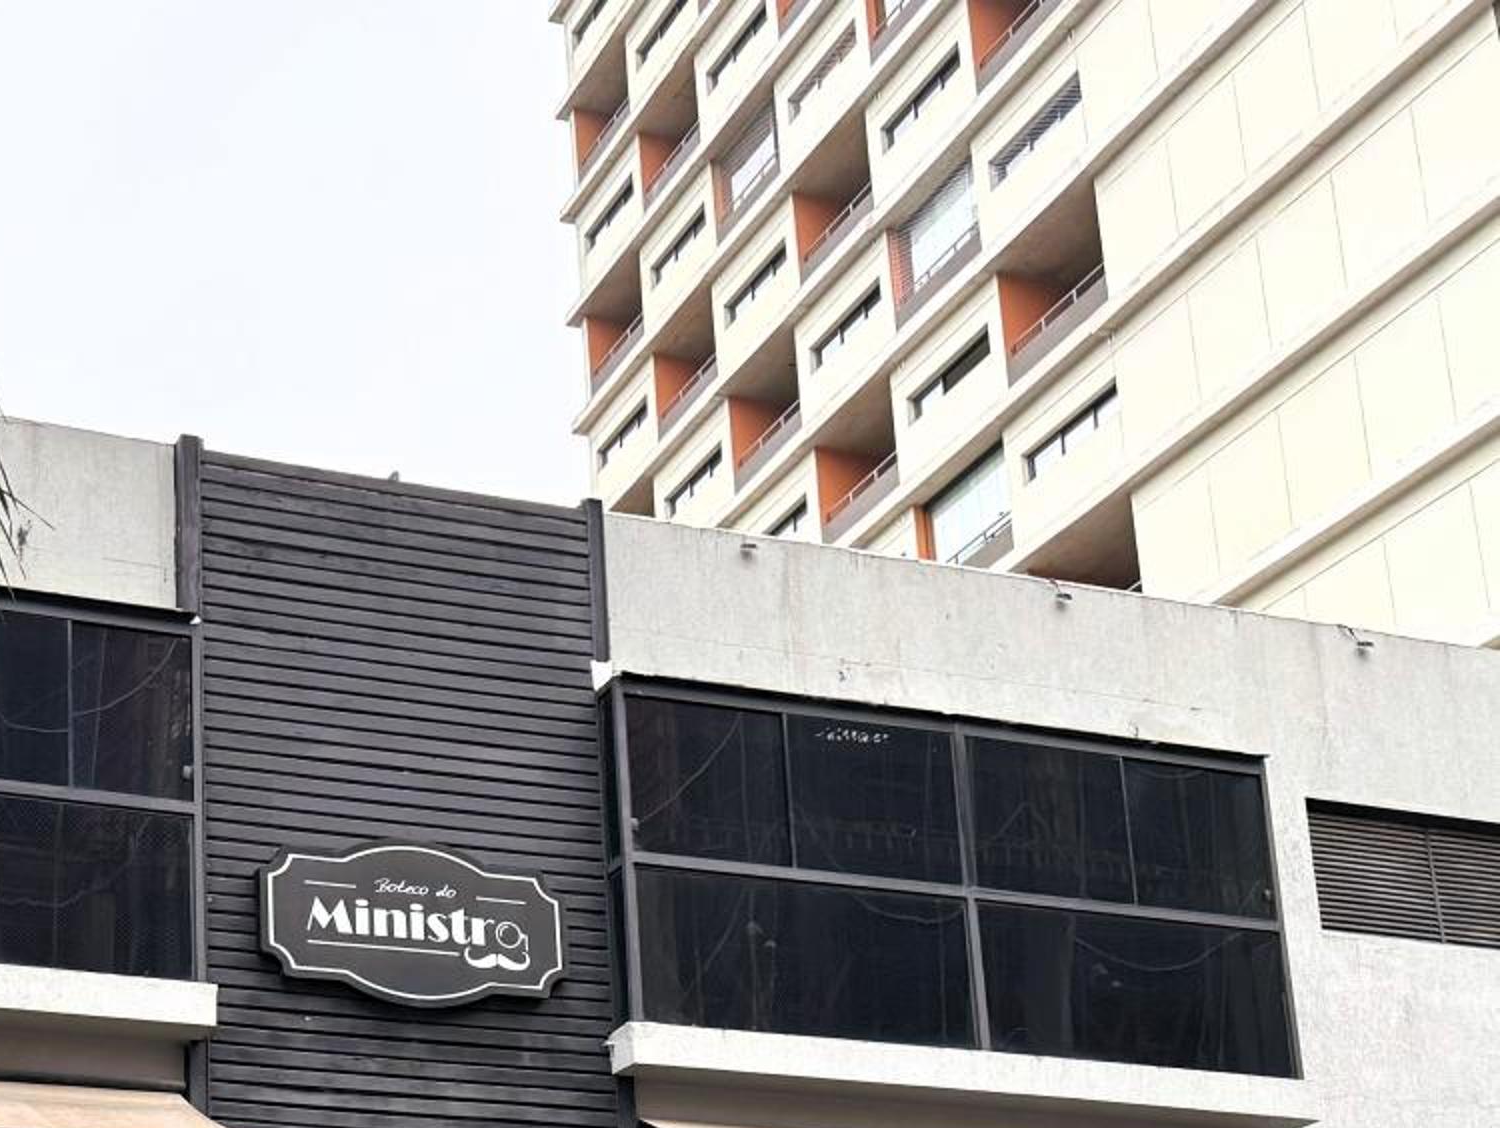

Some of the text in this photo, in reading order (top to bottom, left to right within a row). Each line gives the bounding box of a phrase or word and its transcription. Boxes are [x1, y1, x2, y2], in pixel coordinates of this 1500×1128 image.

[373, 877, 457, 899] Boteco do
[306, 896, 524, 949] Ministro
